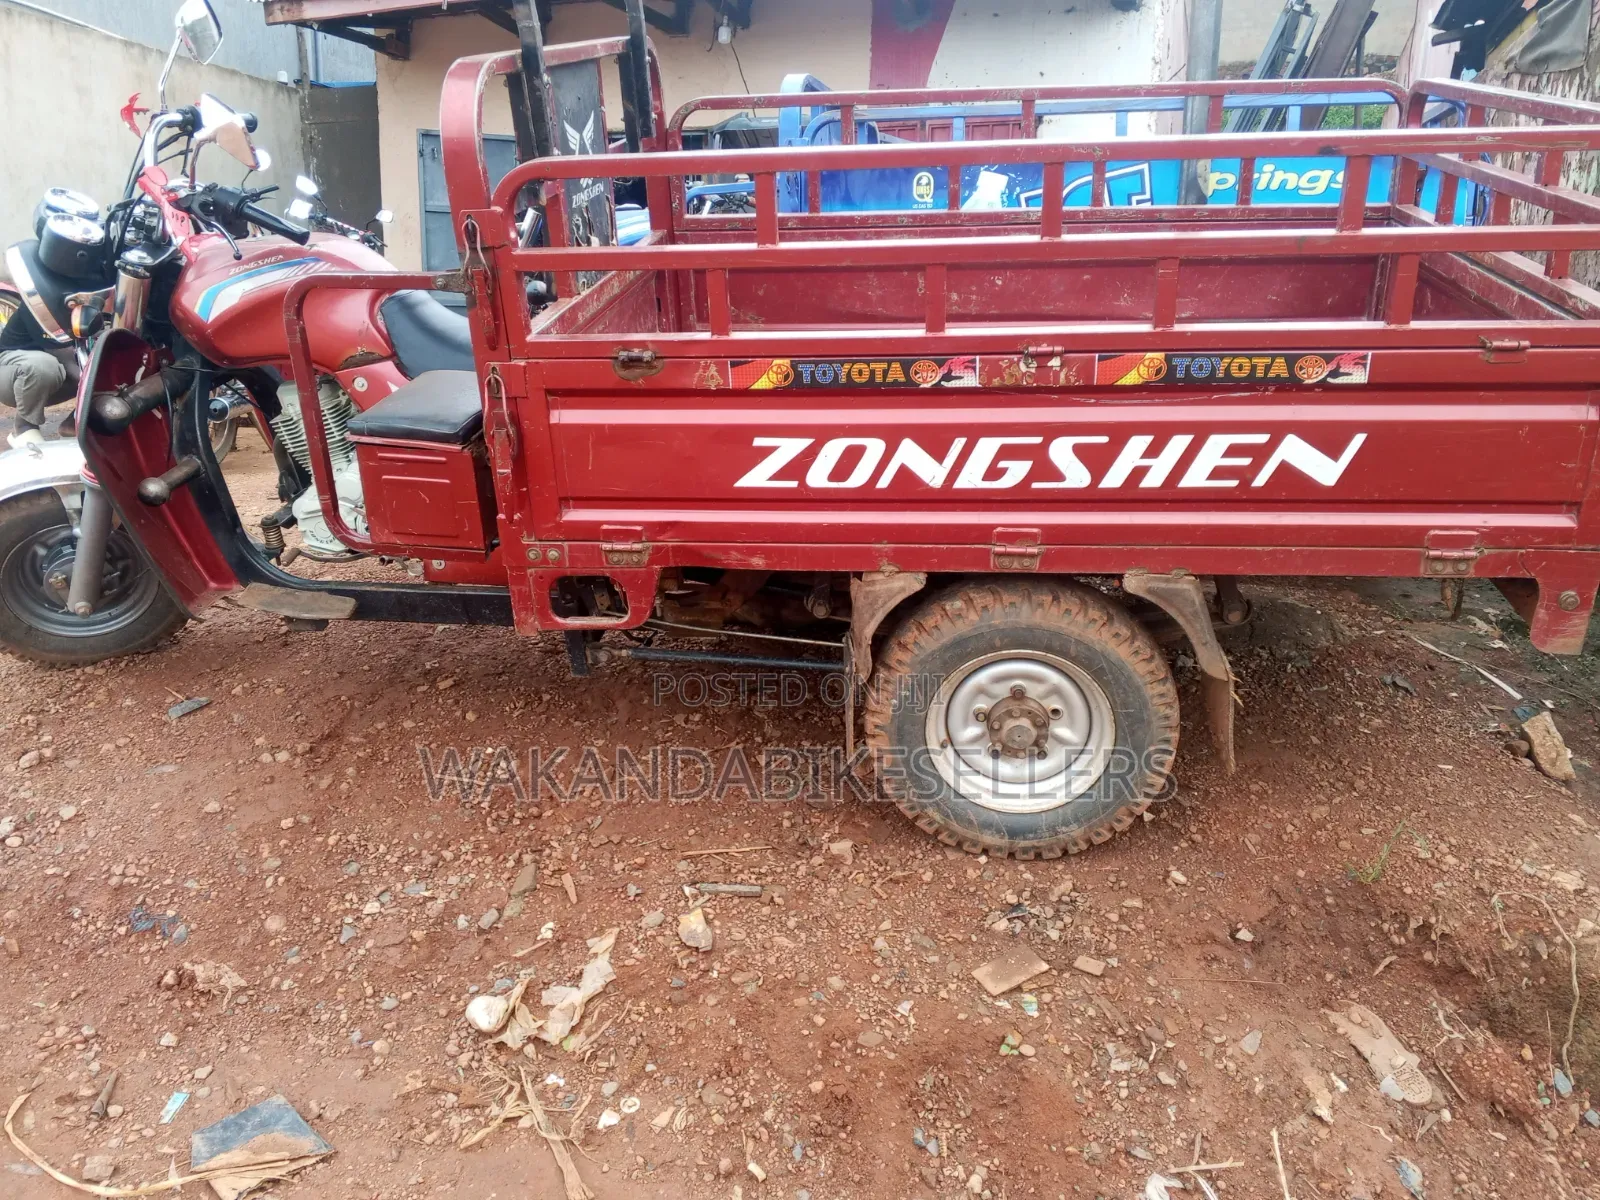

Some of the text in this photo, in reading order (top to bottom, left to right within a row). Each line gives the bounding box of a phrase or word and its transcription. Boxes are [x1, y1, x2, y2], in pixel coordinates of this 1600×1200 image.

[1208, 163, 1345, 197] ping
[229, 255, 284, 275] ZONGSHEN
[798, 362, 906, 384] TOYOTA
[1172, 357, 1289, 379] TOYOTA
[733, 433, 1368, 489] ZONGSHEN
